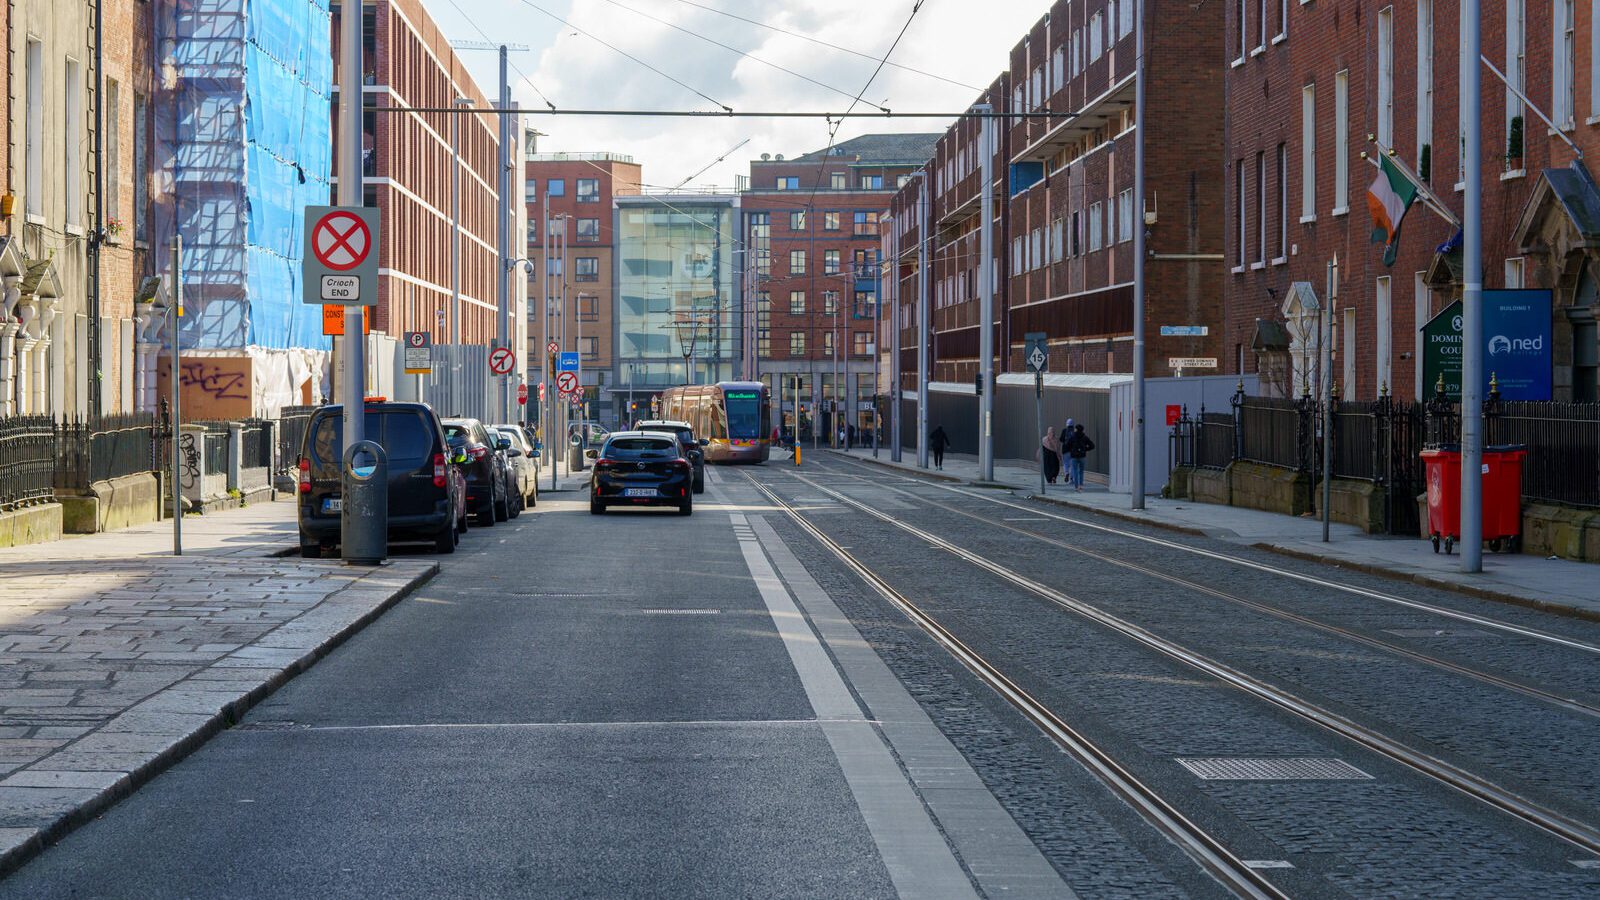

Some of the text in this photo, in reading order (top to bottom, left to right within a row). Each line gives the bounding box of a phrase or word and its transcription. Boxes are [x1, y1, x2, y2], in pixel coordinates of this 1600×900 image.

[326, 278, 354, 287] Crioch
[331, 289, 349, 297] END
[1431, 335, 1464, 343] DOMIN
[1512, 335, 1543, 350] ned
[1440, 346, 1463, 355] COU
[1032, 354, 1043, 362] 15
